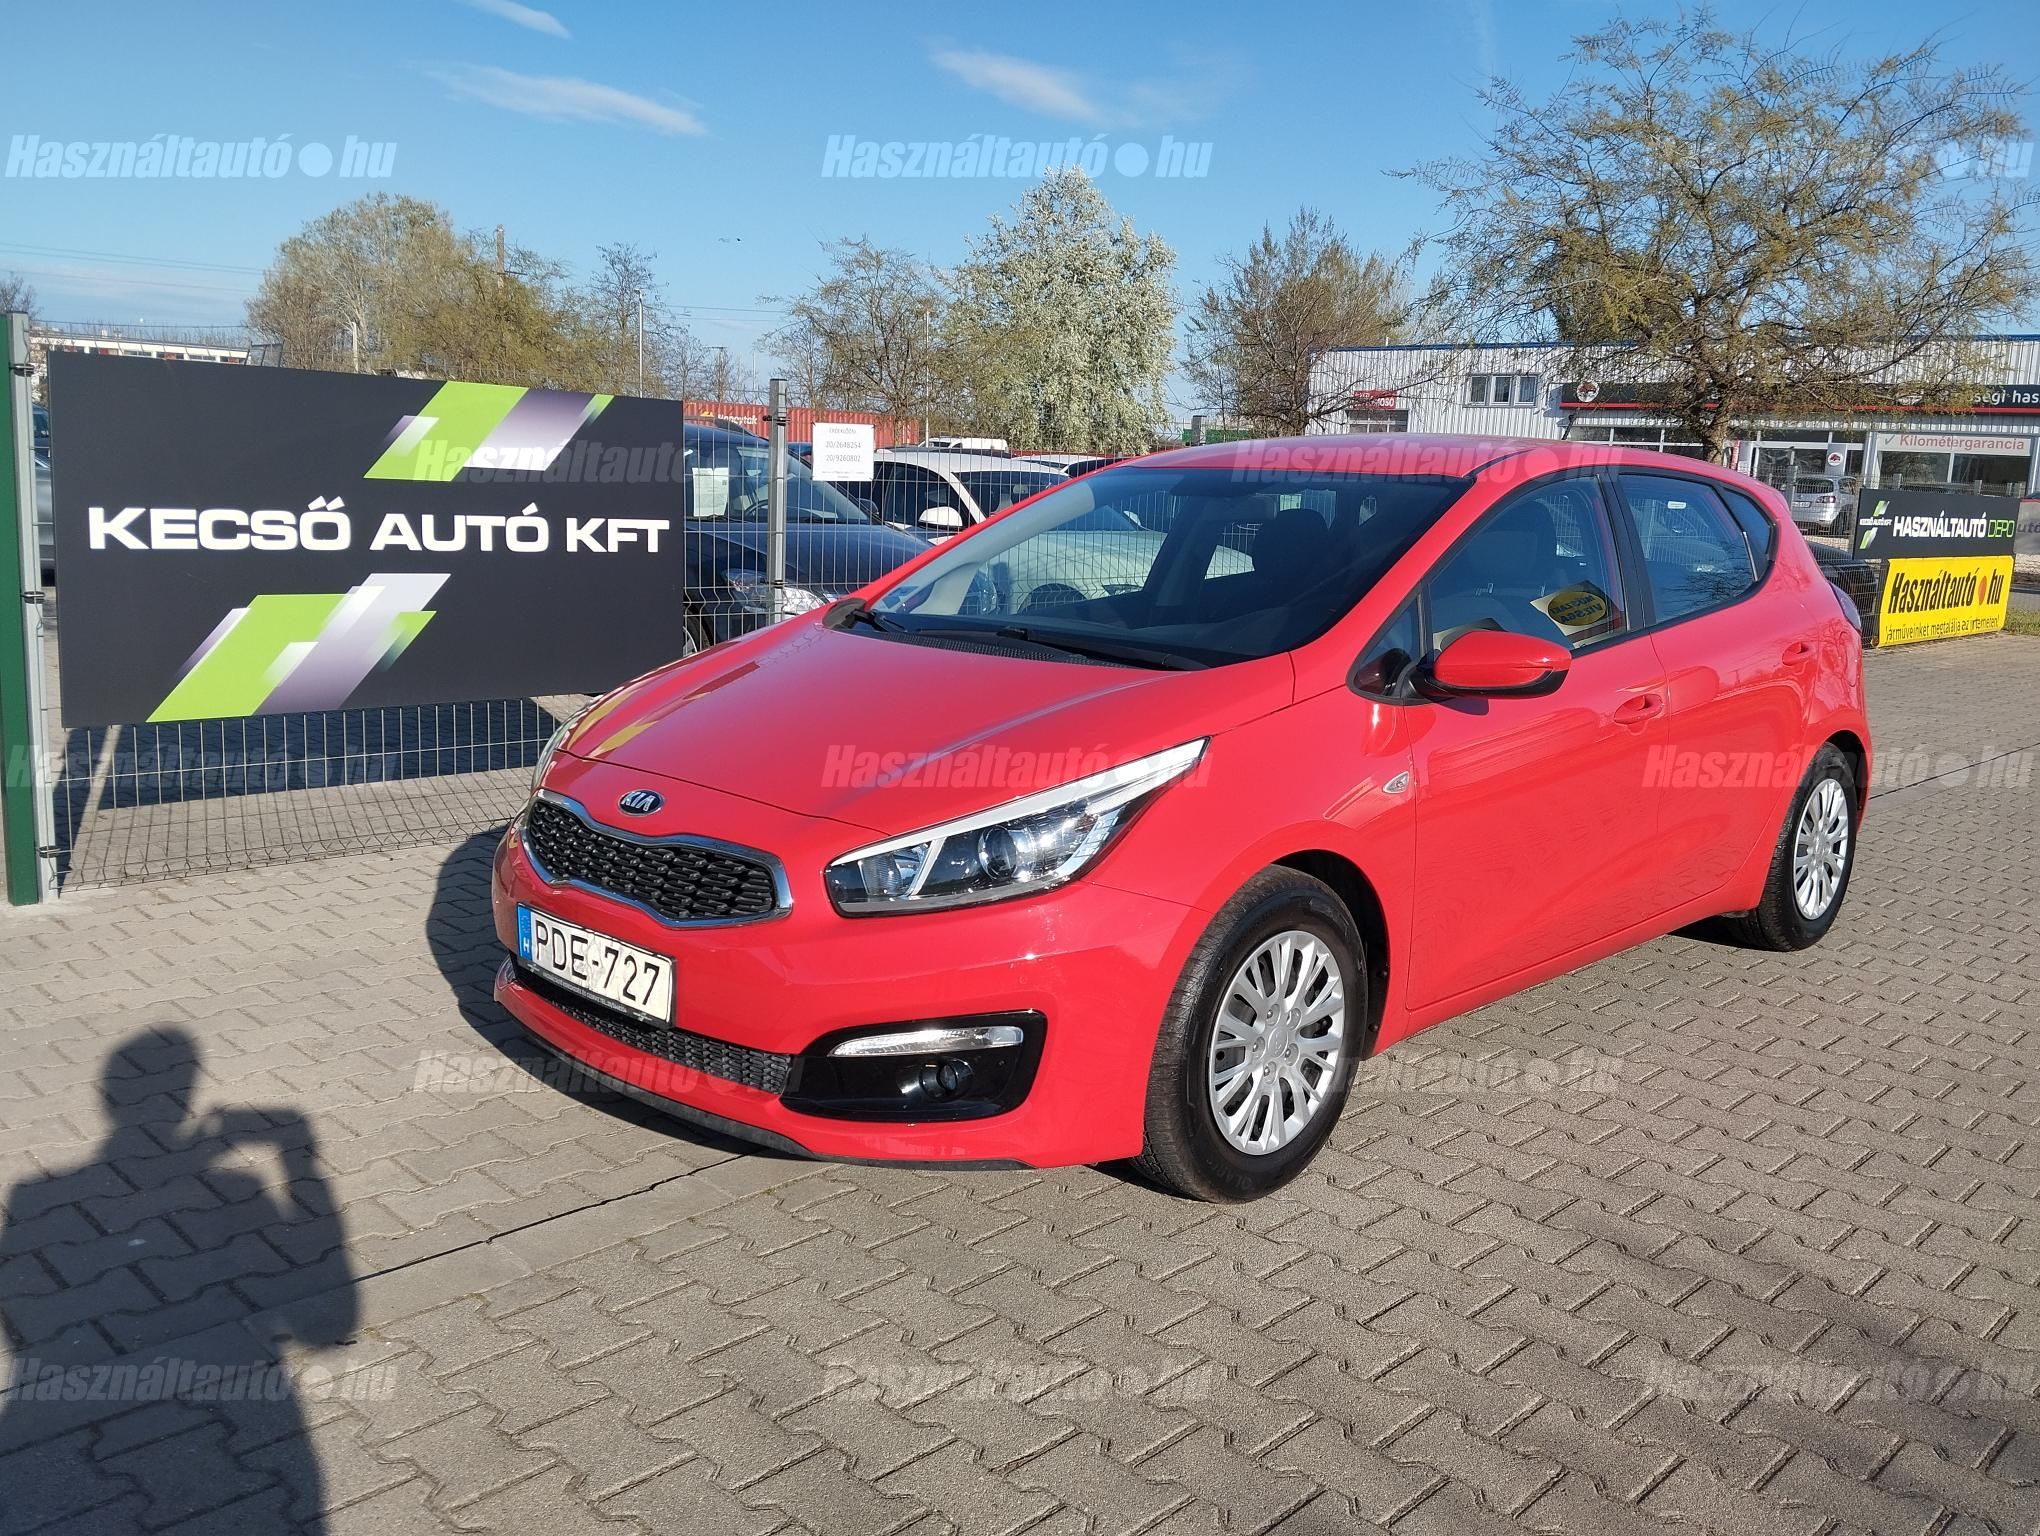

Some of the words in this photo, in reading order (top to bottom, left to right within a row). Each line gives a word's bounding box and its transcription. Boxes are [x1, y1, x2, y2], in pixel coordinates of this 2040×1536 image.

[1900, 434, 2024, 451] Kilométergarancia
[88, 495, 351, 551] KECSŐ
[369, 502, 550, 552] AUTÓ
[566, 517, 670, 553] KFT
[1893, 510, 1987, 538] HASZNÁLTAUTÓ
[1988, 519, 2015, 538] DEPO
[621, 791, 656, 811] KIA
[523, 936, 530, 953] H
[535, 919, 660, 1006] PDE-727
